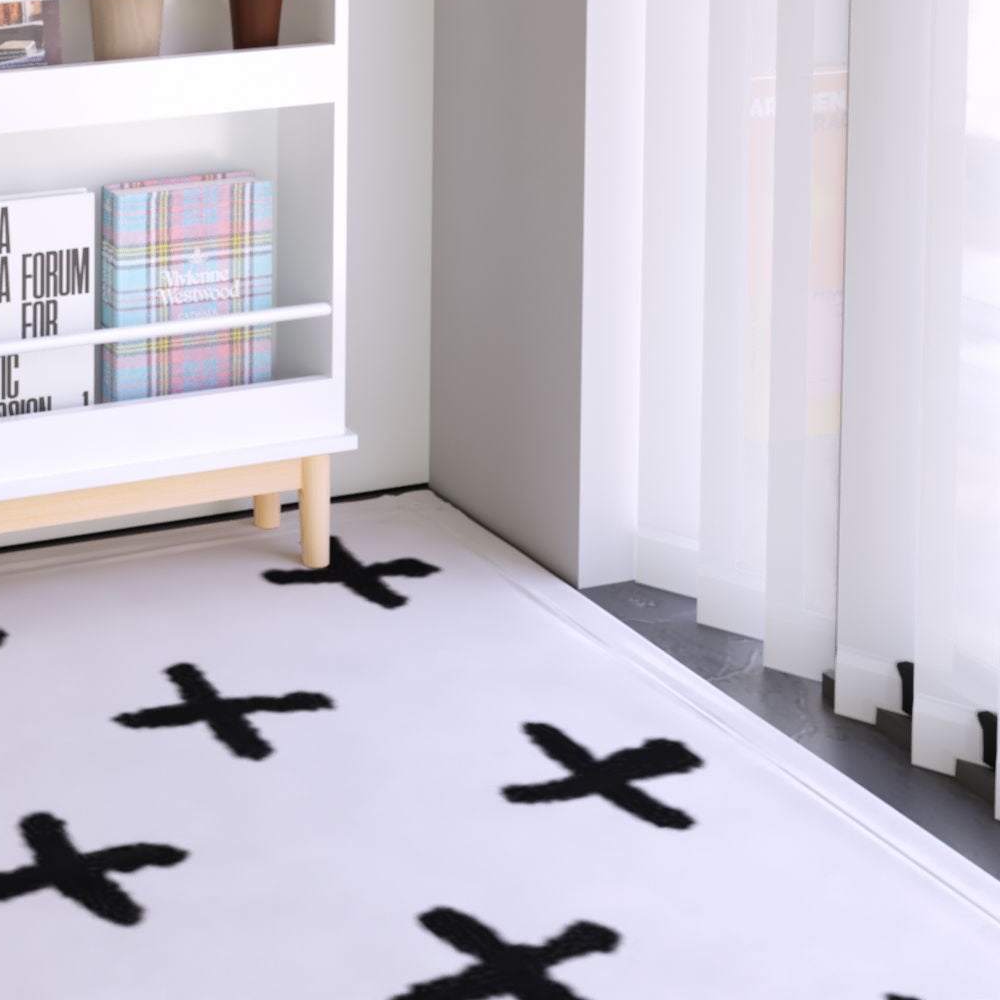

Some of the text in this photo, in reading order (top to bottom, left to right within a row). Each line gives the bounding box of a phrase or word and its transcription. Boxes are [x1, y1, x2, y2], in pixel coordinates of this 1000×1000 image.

[21, 247, 90, 301] FORUM
[160, 268, 229, 287] Vivienne
[158, 279, 240, 306] Westwood
[21, 299, 58, 339] FOR
